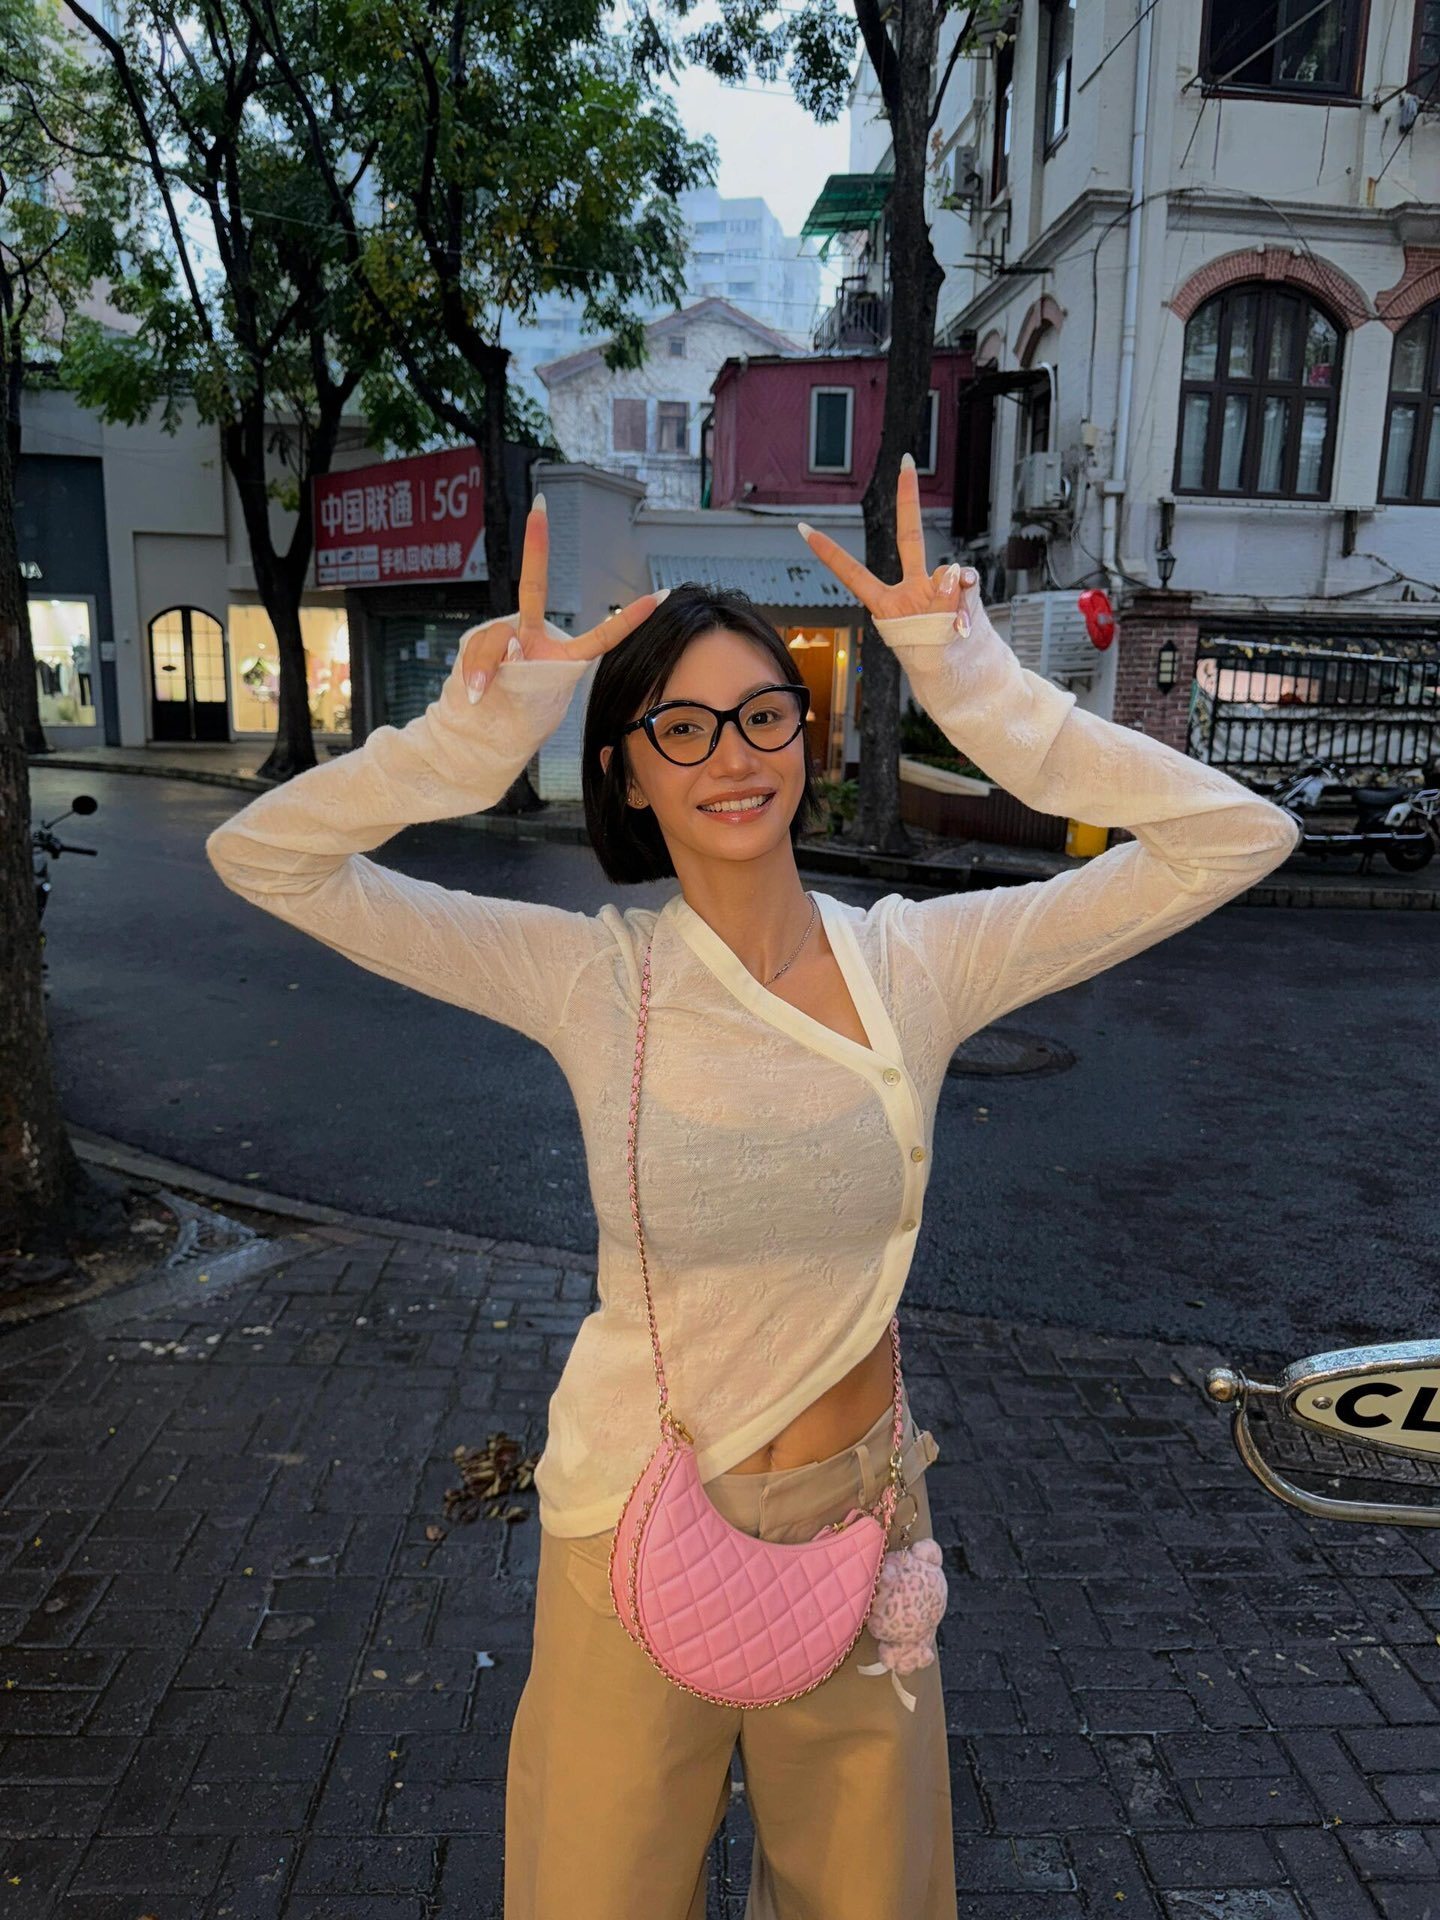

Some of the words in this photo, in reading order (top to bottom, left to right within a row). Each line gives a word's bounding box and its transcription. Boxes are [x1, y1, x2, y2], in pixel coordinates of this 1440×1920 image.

[320, 480, 413, 538] 中国联通
[381, 542, 462, 575] 手机回收维修
[1335, 1382, 1440, 1432] CL
